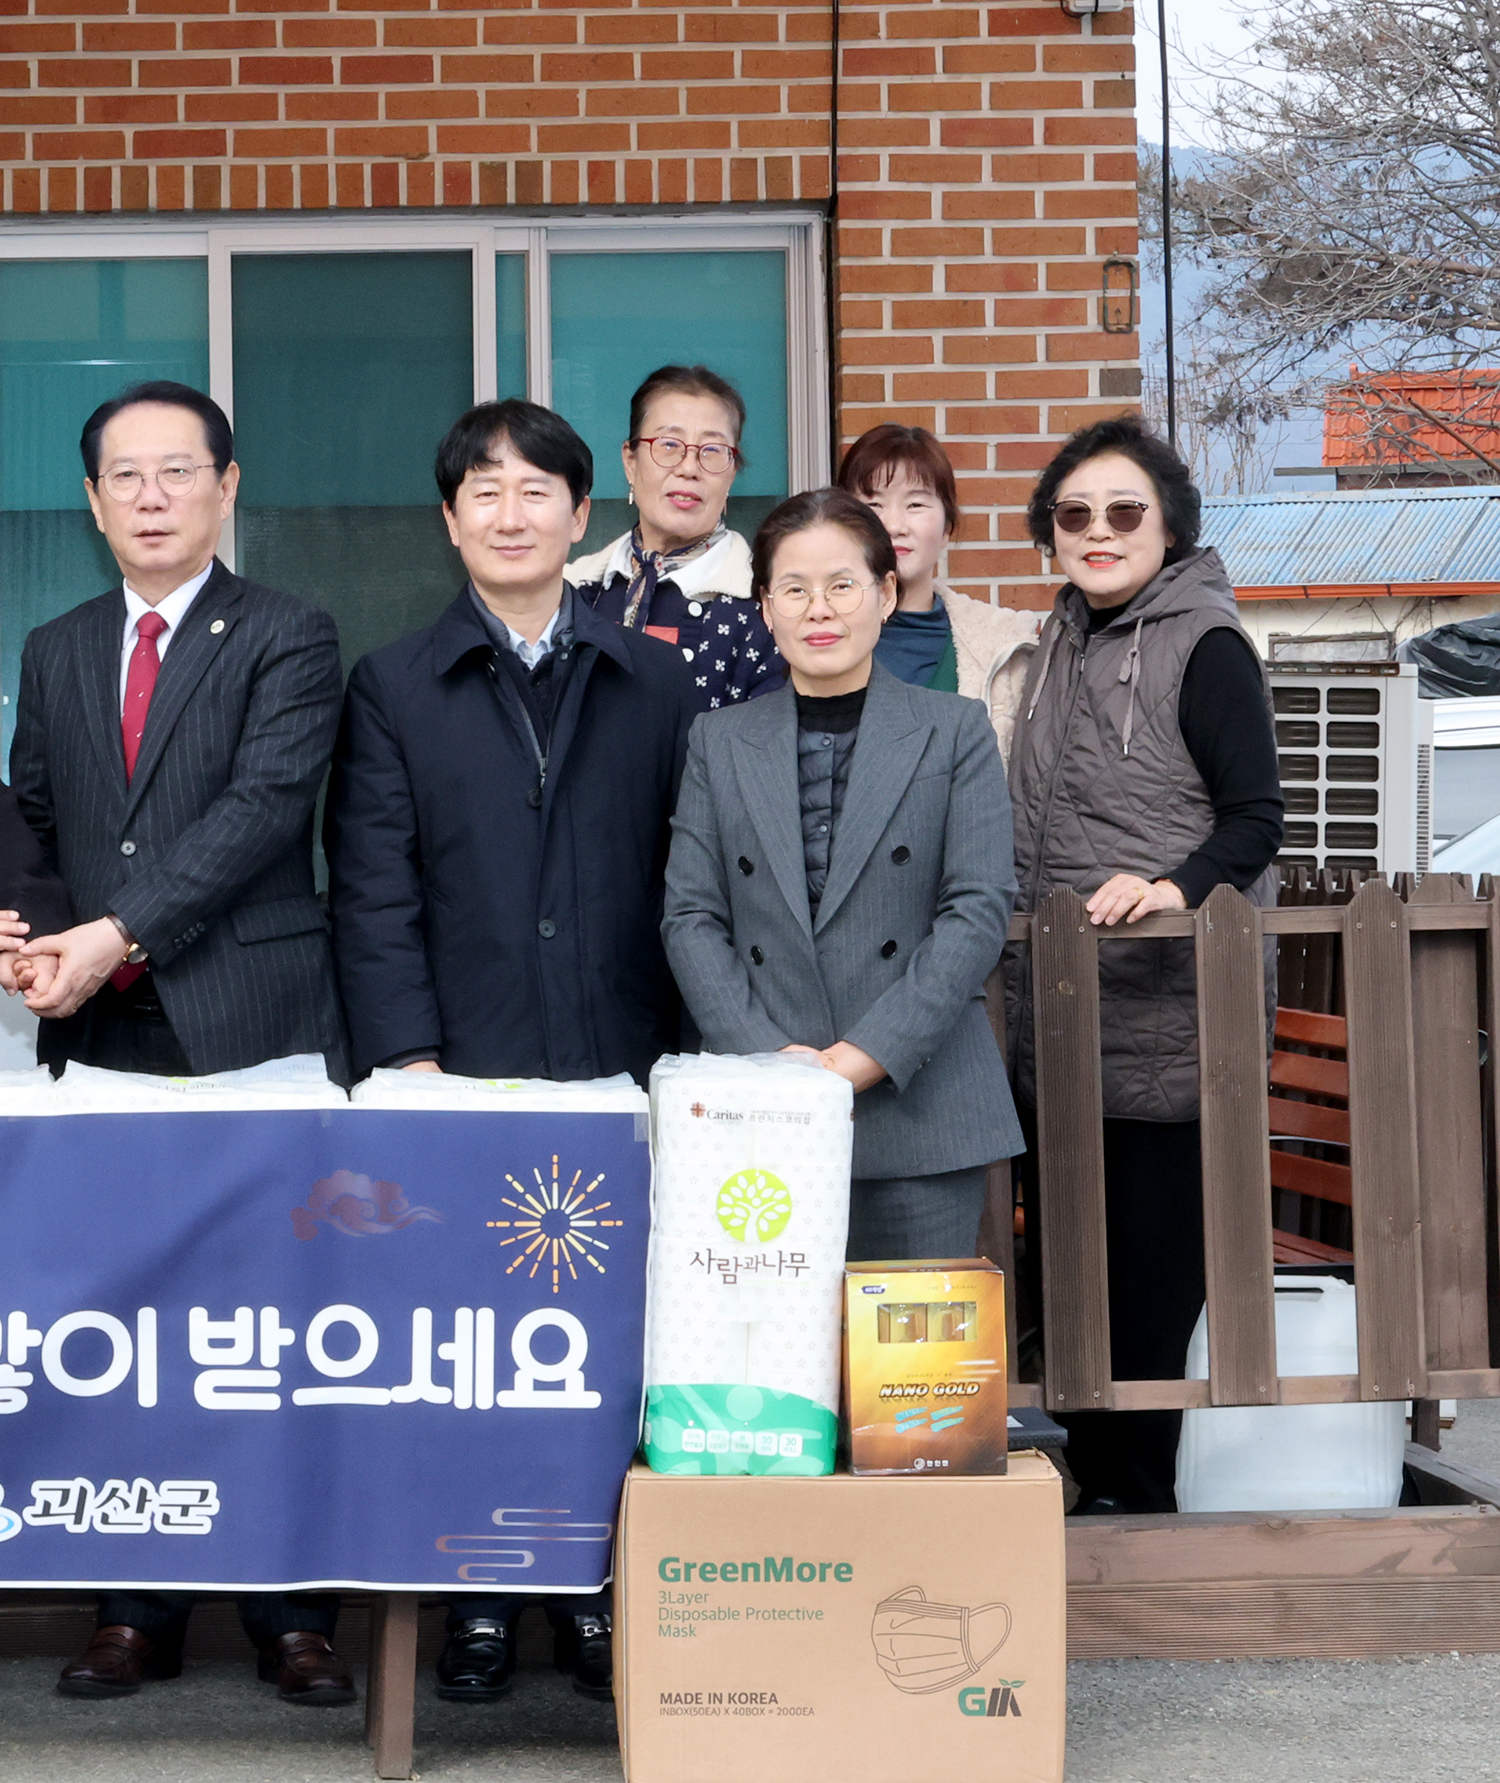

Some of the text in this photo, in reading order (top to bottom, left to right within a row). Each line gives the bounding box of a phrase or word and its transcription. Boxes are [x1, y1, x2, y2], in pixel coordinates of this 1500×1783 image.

[707, 1109, 744, 1120] Caritas
[689, 1248, 810, 1285] 사람과나무
[188, 1304, 602, 1411] 받으세요
[879, 1382, 981, 1398] NANO GOLD
[761, 1436, 773, 1445] 30
[785, 1437, 797, 1446] 30
[26, 1481, 216, 1530] 괴산군
[658, 1557, 854, 1583] GreenMore
[658, 1591, 709, 1606] 3Layer
[658, 1607, 824, 1623] Disposable Protective
[658, 1624, 697, 1637] Mask
[660, 1692, 779, 1705] MADE IN KOREA
[660, 1707, 721, 1716] INBOX(50EA)
[732, 1707, 765, 1716] 40BOX
[776, 1707, 815, 1716] 2000EA
